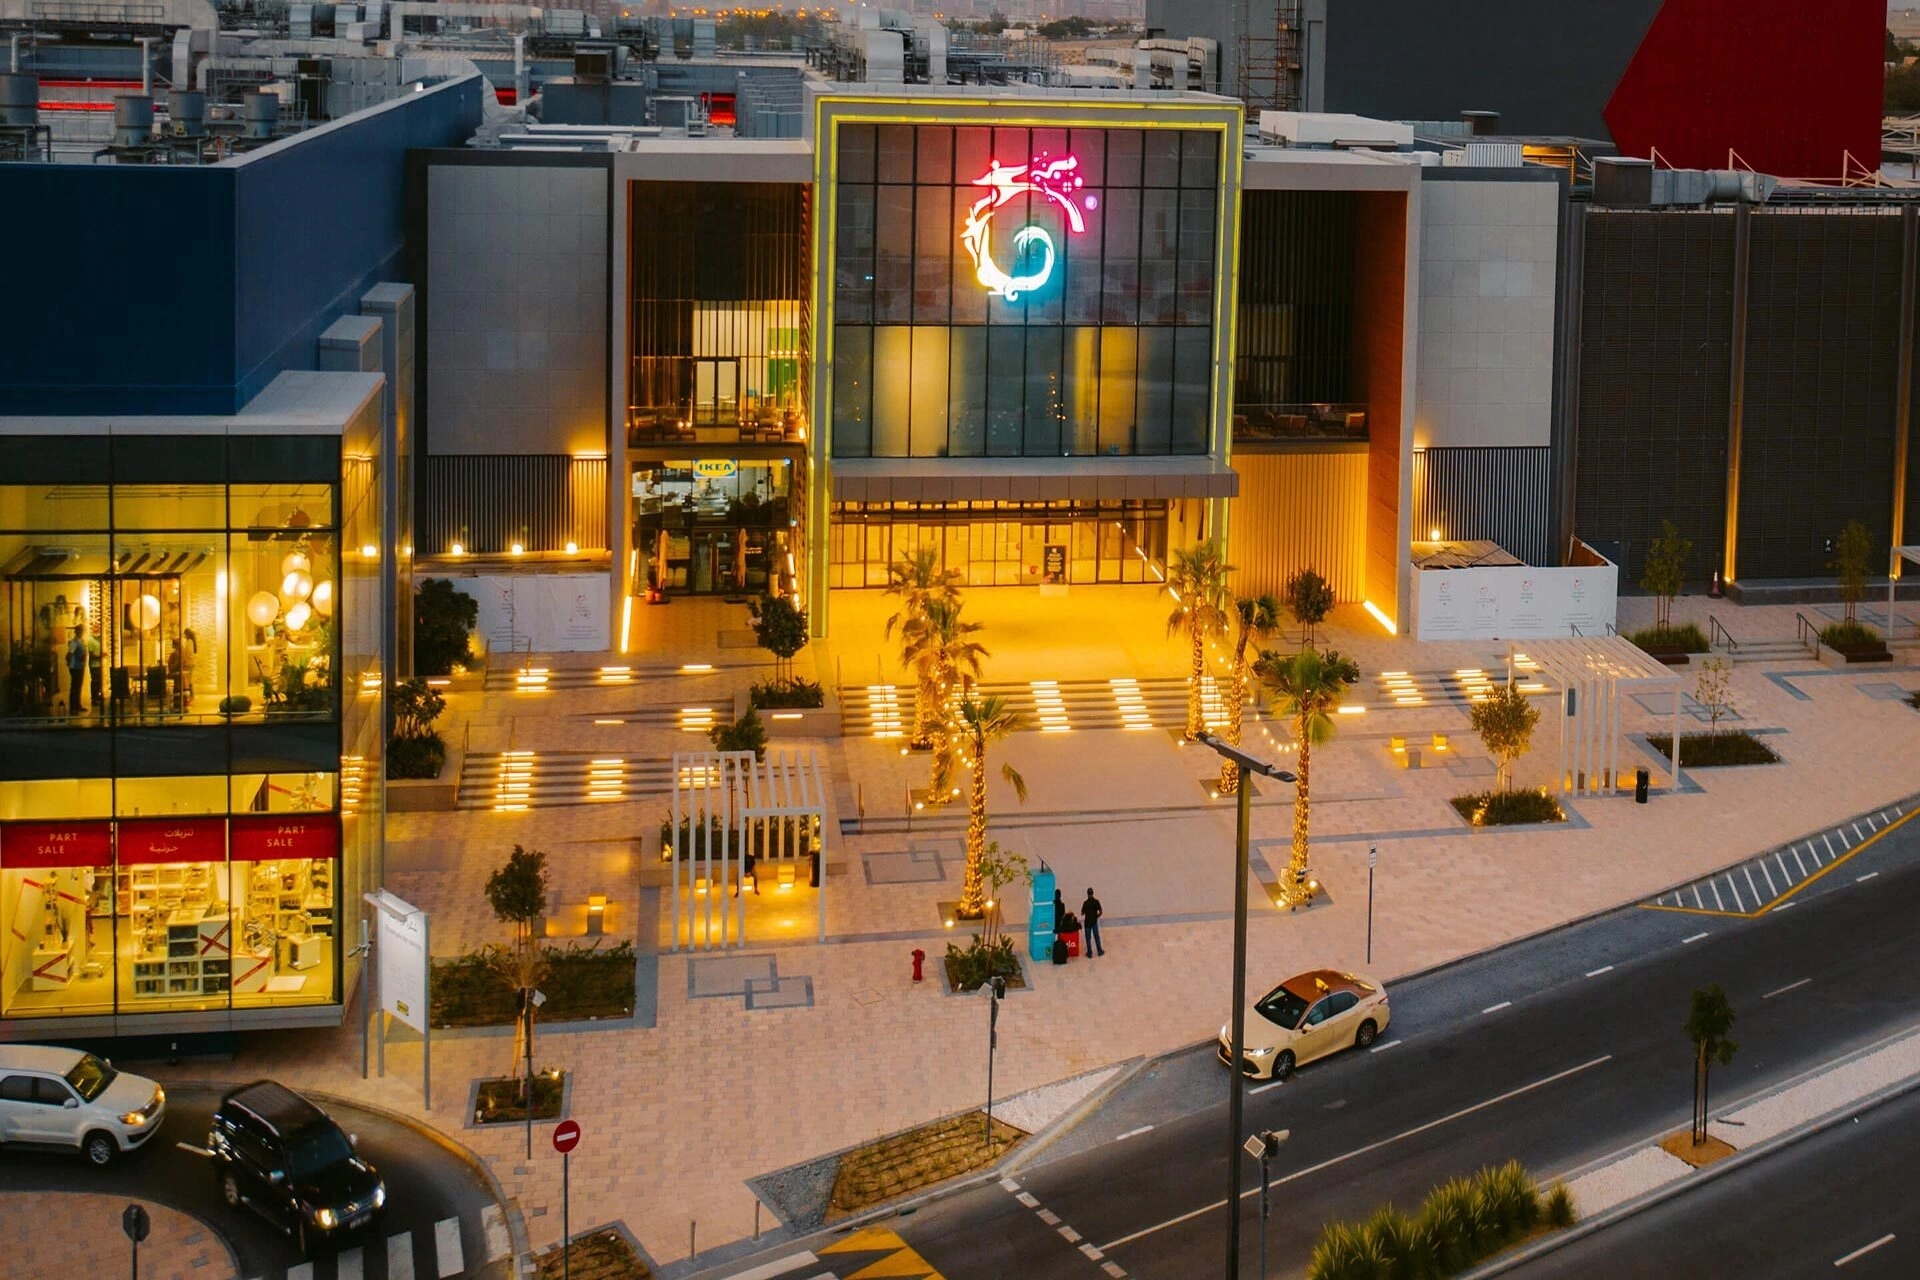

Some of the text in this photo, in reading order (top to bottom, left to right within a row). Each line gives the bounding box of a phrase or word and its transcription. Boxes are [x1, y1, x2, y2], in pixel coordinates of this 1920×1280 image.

[699, 463, 731, 471] IKEA
[278, 825, 305, 835] PART
[50, 832, 78, 841] PART
[266, 837, 293, 847] SALE
[38, 845, 65, 855] SALE
